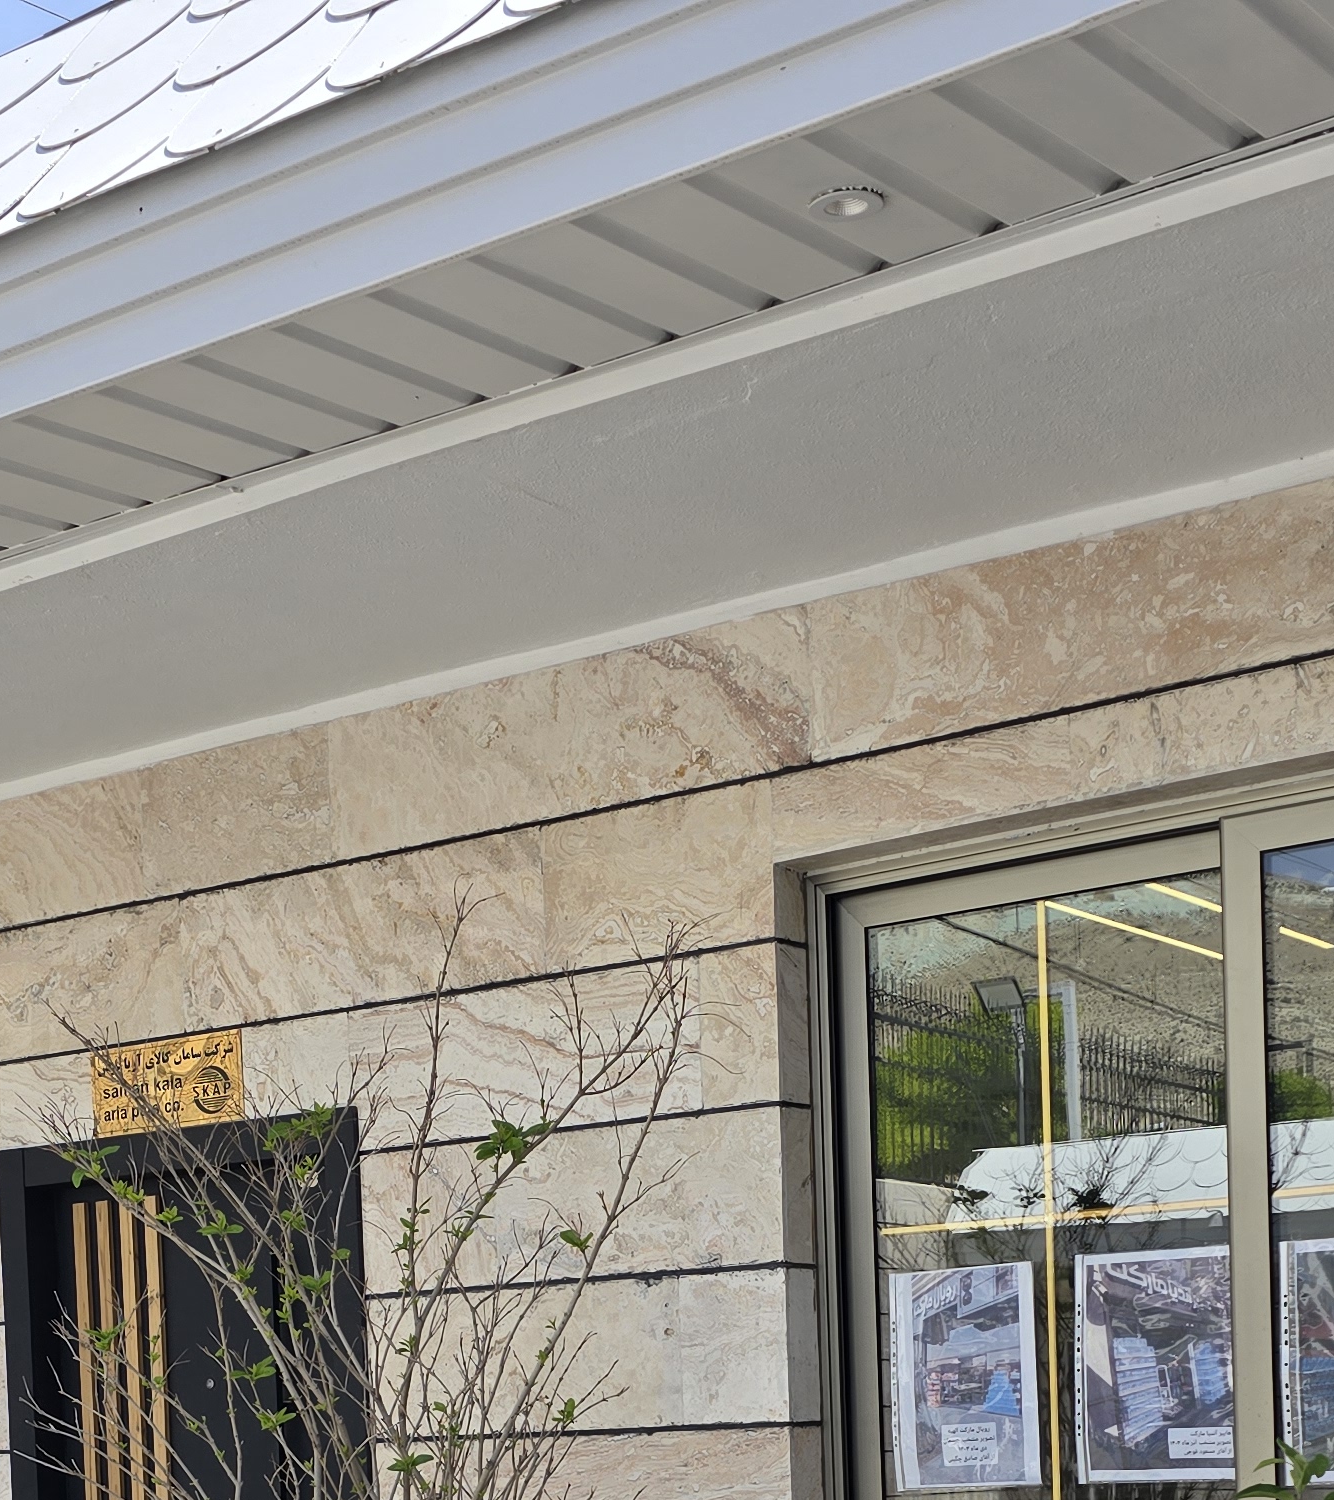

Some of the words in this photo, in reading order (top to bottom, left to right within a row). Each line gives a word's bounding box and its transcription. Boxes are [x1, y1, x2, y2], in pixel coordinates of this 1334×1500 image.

[173, 1046, 202, 1065] سامان
[204, 1040, 234, 1059] شرکت
[145, 1050, 171, 1070] کالای
[154, 1075, 183, 1092] kala
[193, 1082, 231, 1098] SKAP
[104, 1106, 127, 1122] aria
